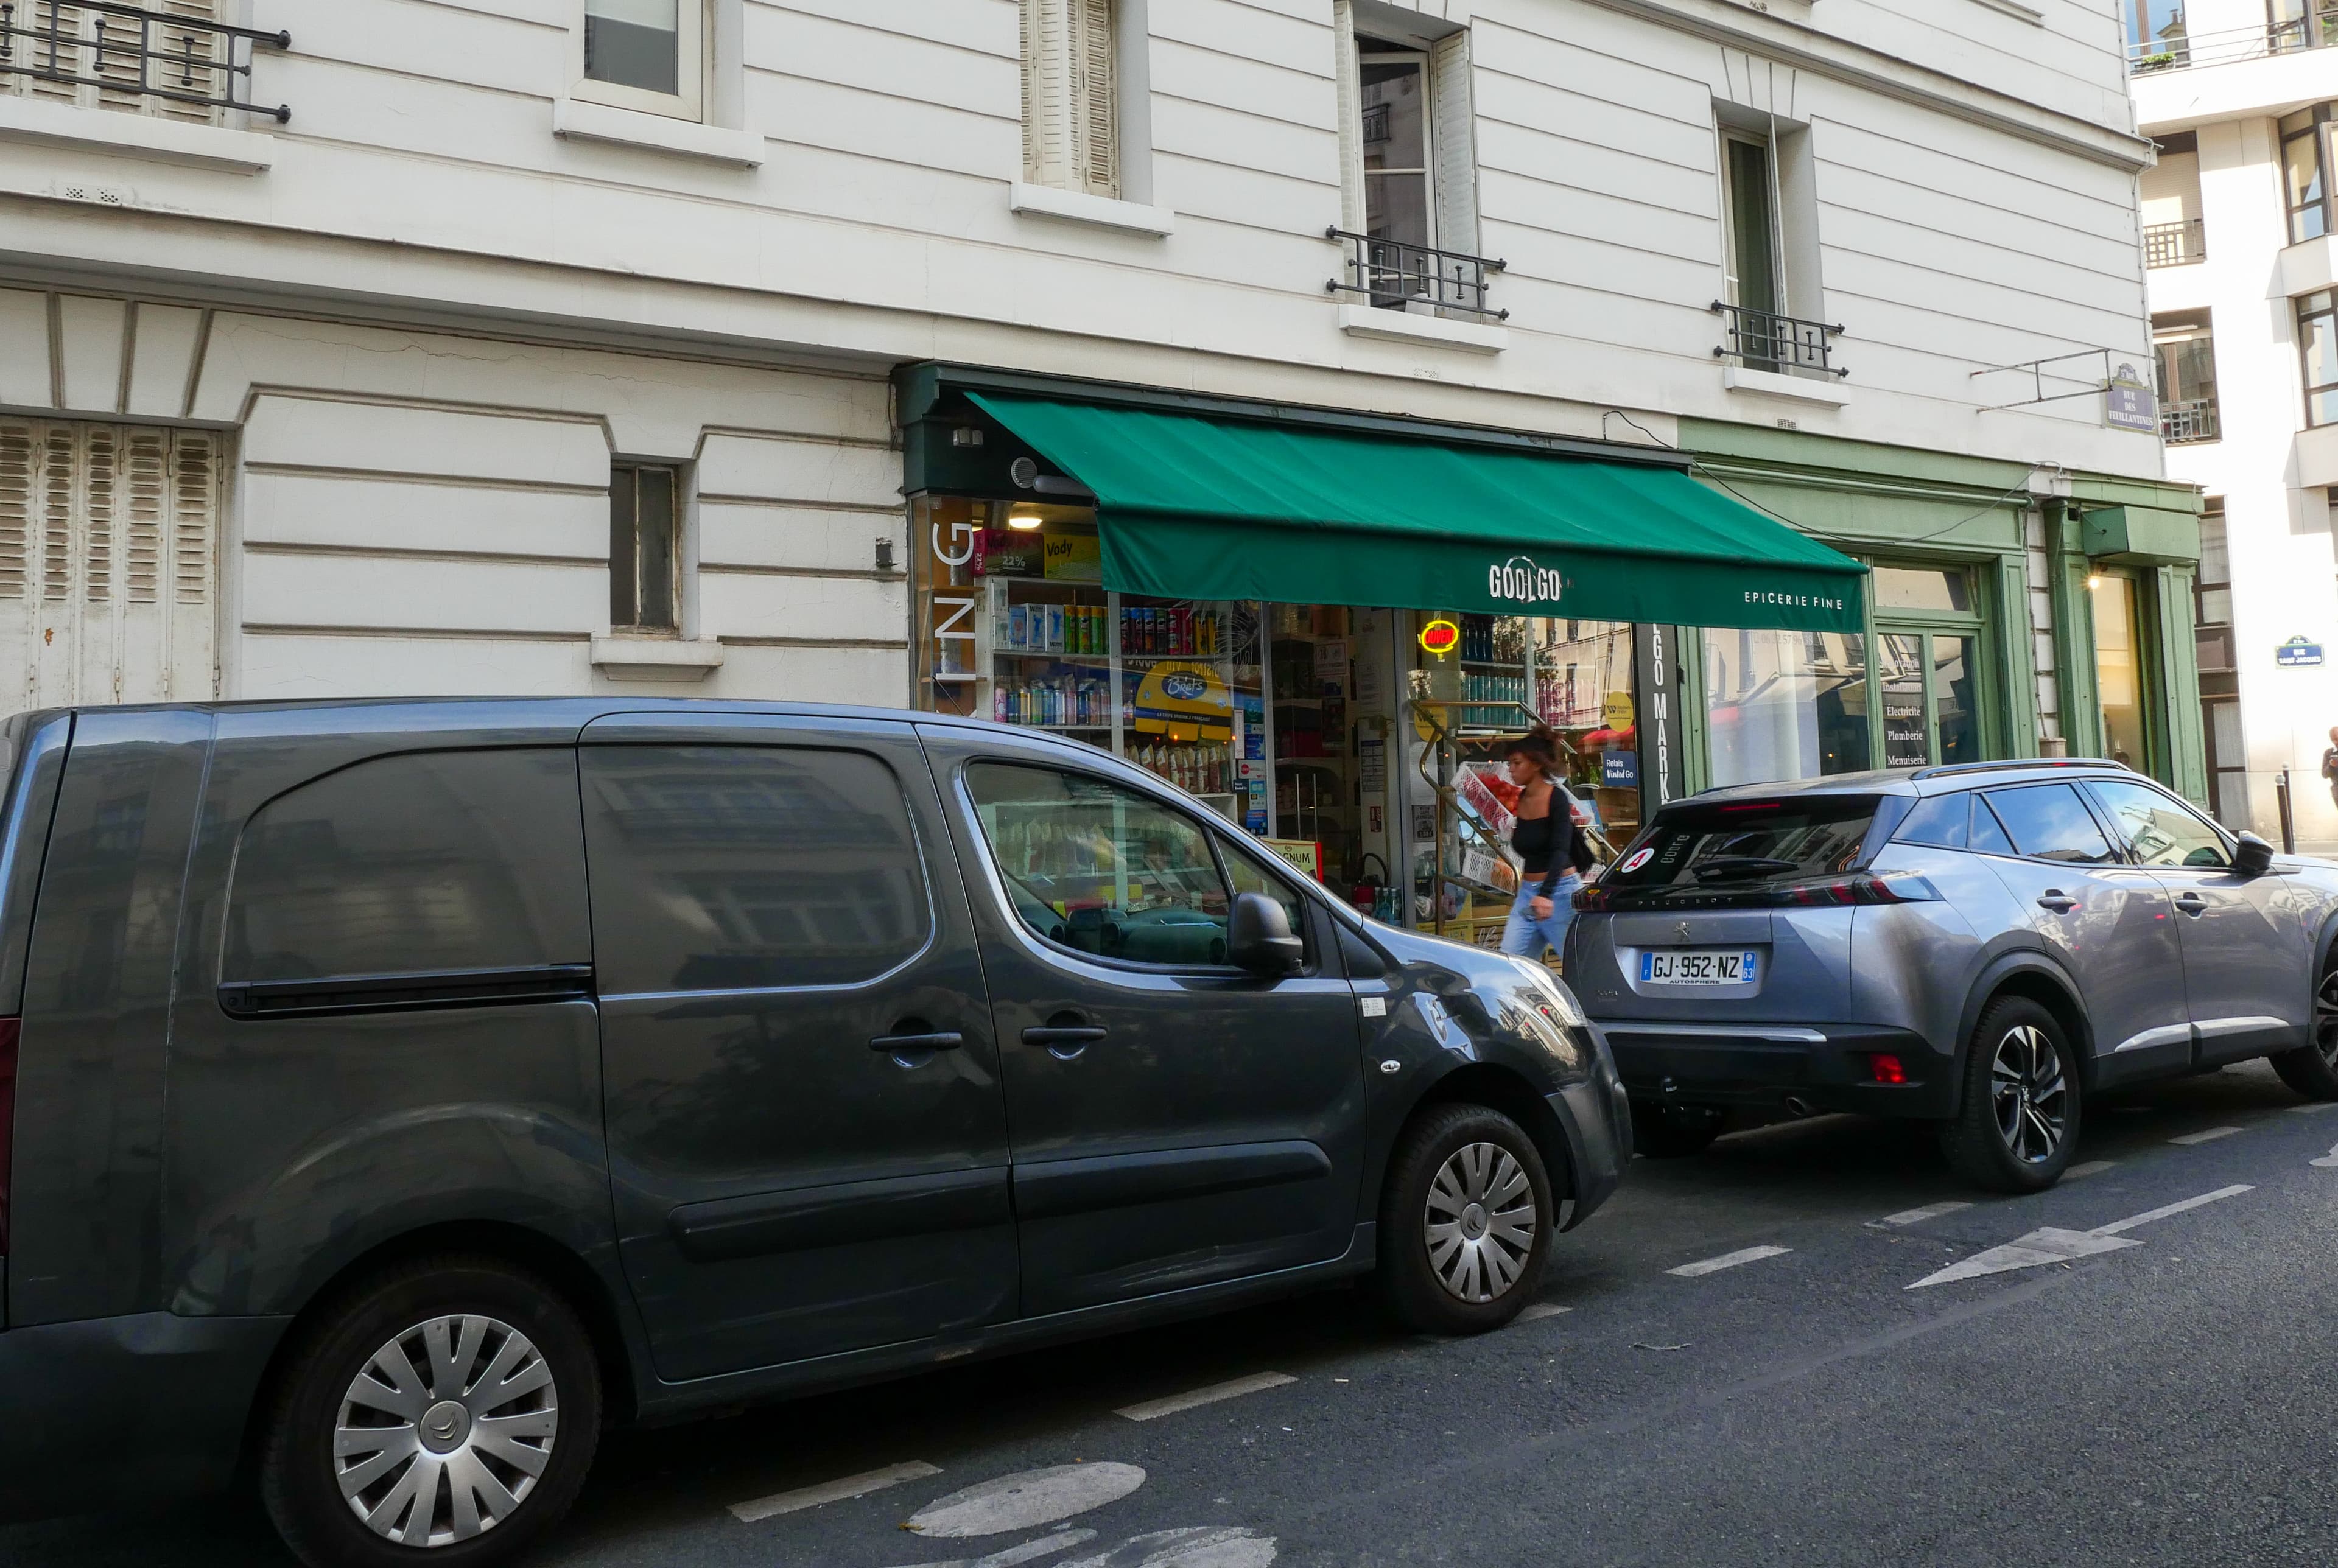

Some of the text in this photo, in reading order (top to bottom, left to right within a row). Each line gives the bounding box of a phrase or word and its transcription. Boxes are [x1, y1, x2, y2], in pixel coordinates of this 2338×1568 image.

[2123, 390, 2135, 401] RUE
[2124, 402, 2136, 411] DES
[2108, 410, 2153, 426] FEUILLANTINES
[1047, 539, 1072, 557] Vody
[1002, 555, 1026, 567] 22%
[1744, 592, 1842, 610] EPICERIE FINE
[932, 522, 977, 716] ING
[1887, 704, 1921, 716] Électricité
[1887, 730, 1923, 741] Plomberie
[1654, 693, 1670, 805] MARK
[1606, 759, 1623, 768] Relais
[1887, 754, 1926, 766] Menuiserie
[1606, 769, 1625, 779] Vinted
[1279, 852, 1310, 863] GNUM
[1625, 852, 1648, 869] A
[1743, 968, 1754, 979] 63
